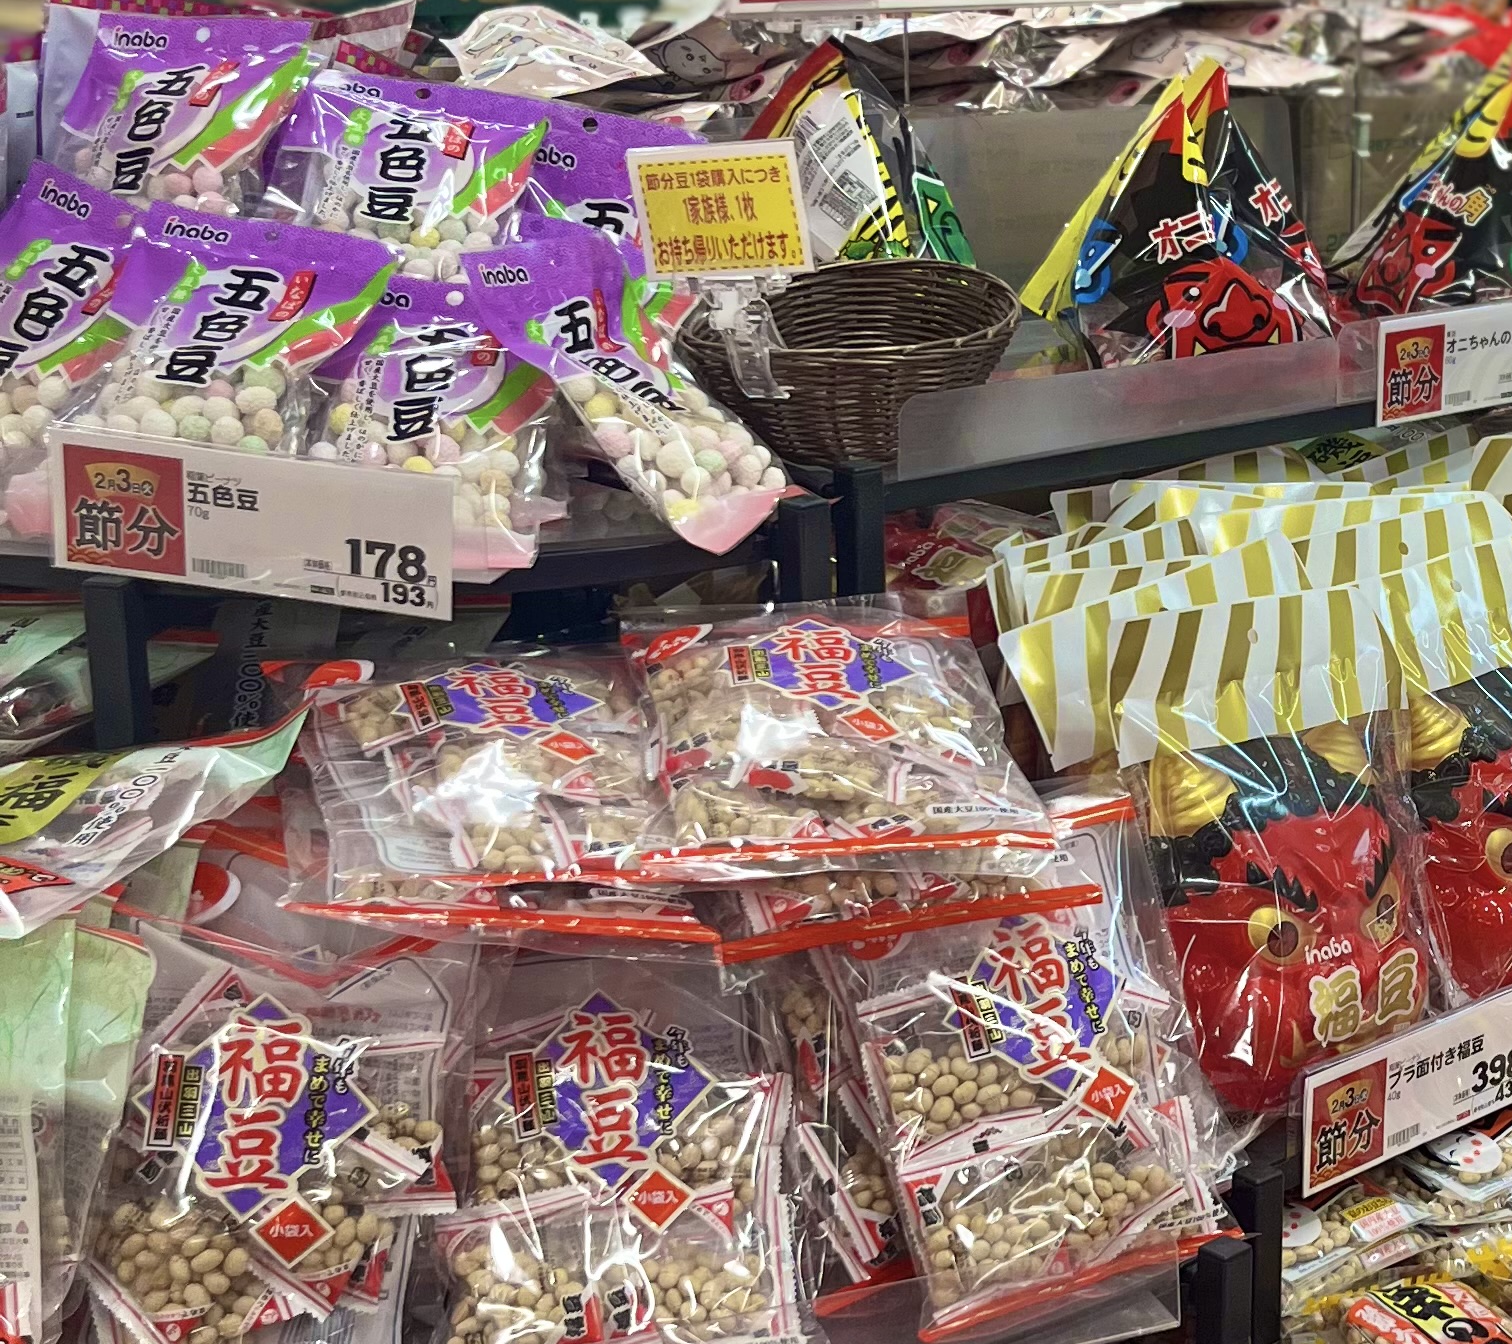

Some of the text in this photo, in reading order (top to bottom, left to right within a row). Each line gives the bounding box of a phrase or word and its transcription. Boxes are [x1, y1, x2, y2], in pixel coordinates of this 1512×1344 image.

[113, 25, 168, 49] inaba
[111, 65, 210, 194] 五色豆
[39, 179, 92, 219] inaba
[644, 166, 781, 192] 節分豆1袋購入につき
[163, 216, 230, 245] inaba
[656, 230, 797, 266] お持ち帰りいただけます。
[480, 265, 530, 287] inaba
[157, 268, 282, 387] 五色豆
[1388, 364, 1440, 408] 節分
[186, 482, 260, 512] 五色豆
[187, 505, 210, 520] 70g
[73, 497, 180, 556] 節分
[345, 538, 427, 584] 178
[382, 582, 426, 608] 193
[772, 628, 860, 701] 福豆
[446, 668, 553, 729] 福豆
[1304, 937, 1354, 966] inaba
[989, 921, 1092, 1077] 福豆
[1063, 940, 1106, 1034] まめで幸せに
[1311, 947, 1421, 1047] 福豆
[1388, 1033, 1486, 1090] プラ面付き福豆
[176, 1066, 203, 1138] 出羽三山
[203, 1016, 306, 1190] 福豆
[303, 1053, 329, 1165] まめで幸せに
[560, 1013, 649, 1167] 福豆
[1316, 1108, 1382, 1172] 節分
[636, 1189, 680, 1206] 小袋入
[268, 1223, 315, 1239] 小袋入
